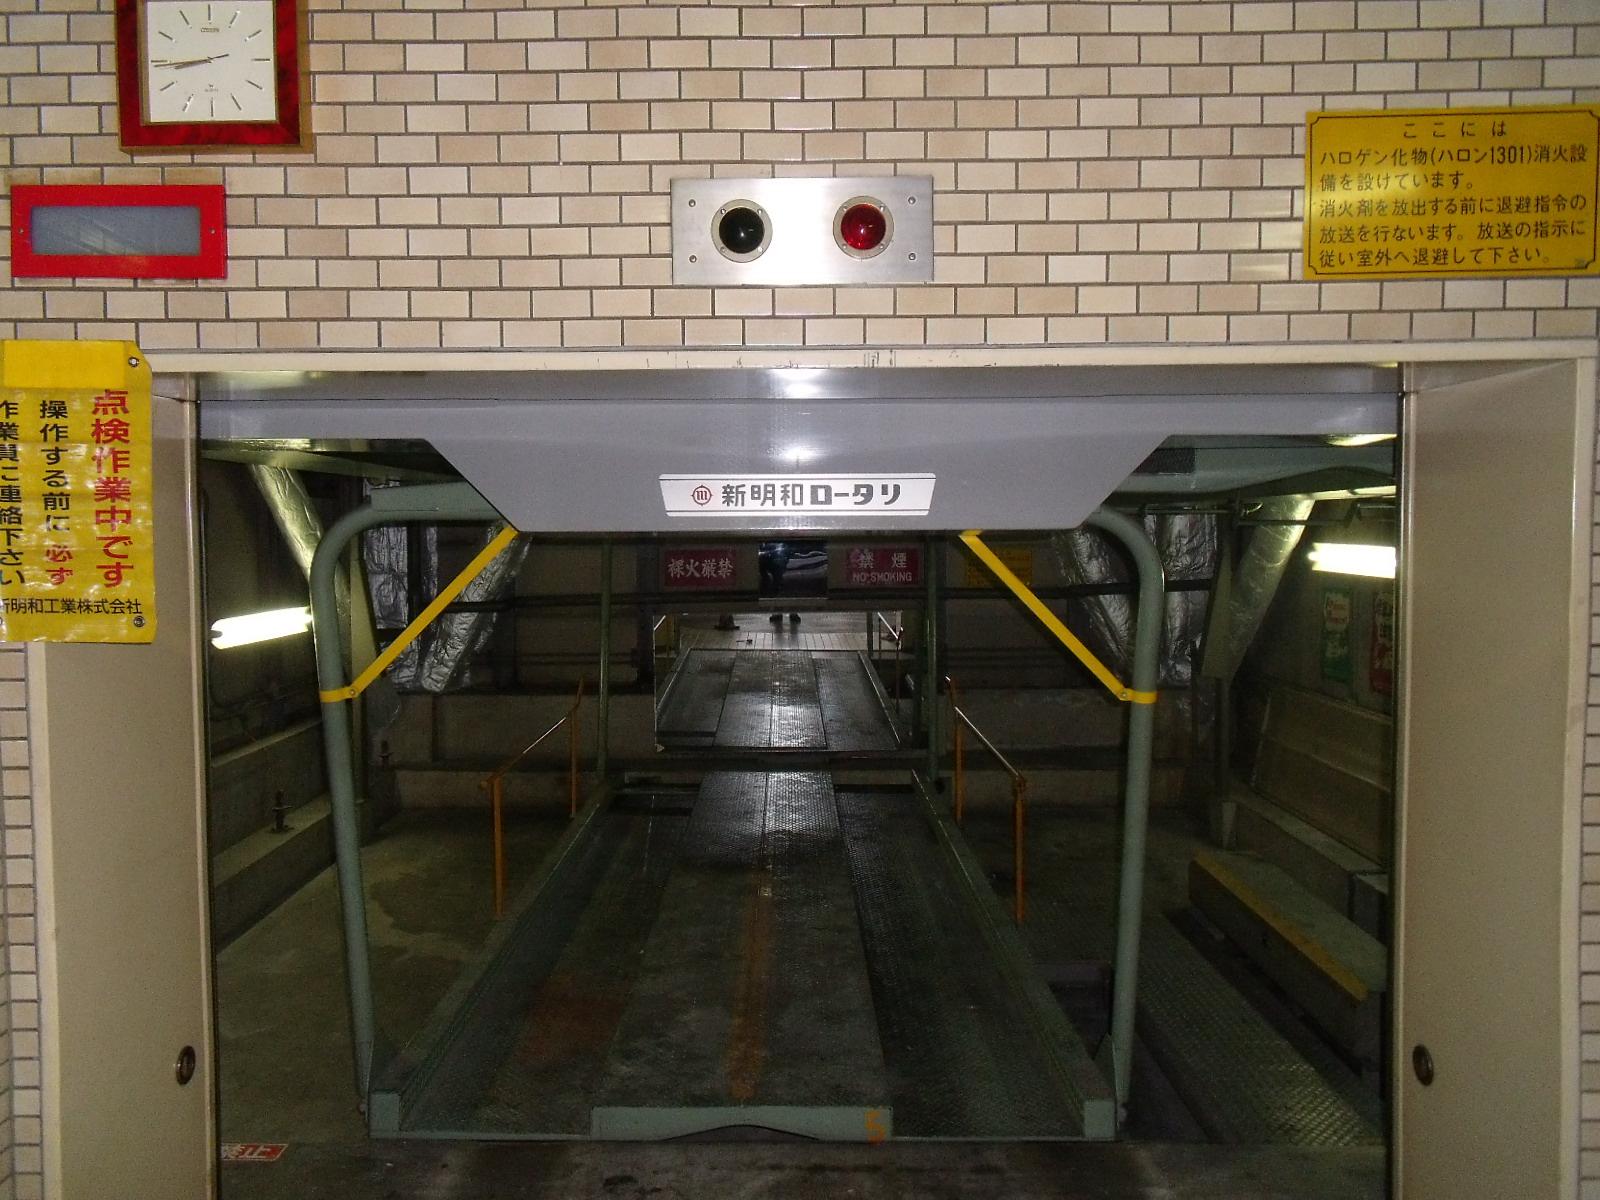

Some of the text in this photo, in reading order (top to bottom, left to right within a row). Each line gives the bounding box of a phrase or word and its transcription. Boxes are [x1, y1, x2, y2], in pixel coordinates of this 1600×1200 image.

[1403, 120, 1507, 139] ここには
[1320, 144, 1588, 167] ハロゲン化物(ハロン1301)消火設
[1320, 170, 1474, 192] 備を設けています。
[1319, 194, 1587, 217] 消火剤を放出する前に退避指令の
[1319, 221, 1586, 245] 放送を行ないます。放送の指示に
[1319, 246, 1550, 269] 従い室外へ退避して下さい。
[91, 388, 134, 588] 点検作業中です
[721, 484, 901, 507] 新明和ロータリ
[870, 571, 913, 583] SMOKING
